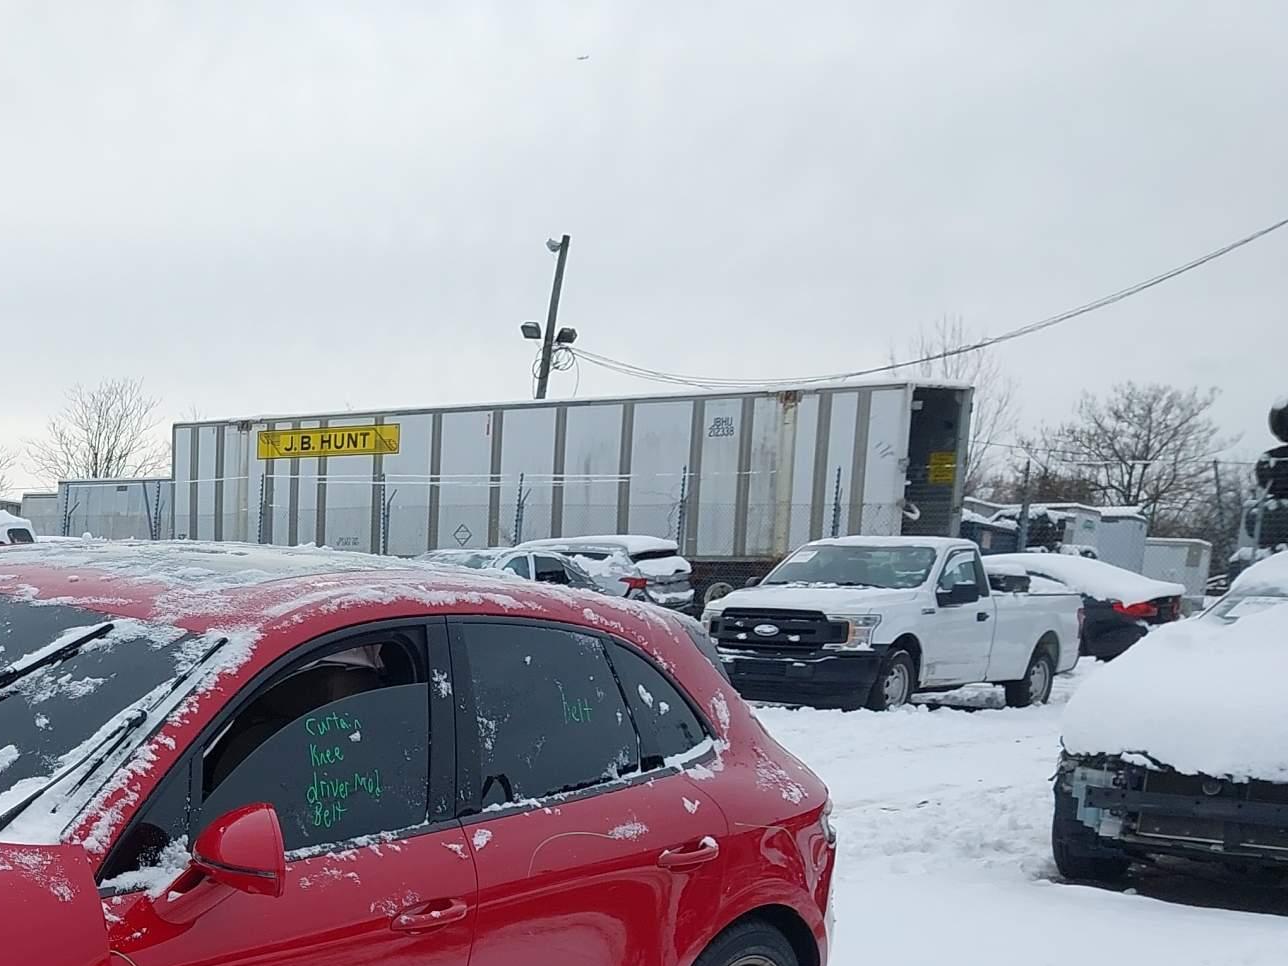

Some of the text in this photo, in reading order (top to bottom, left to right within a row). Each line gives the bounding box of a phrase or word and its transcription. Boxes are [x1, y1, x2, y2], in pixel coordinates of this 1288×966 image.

[284, 431, 370, 452] J.B. HUNT
[310, 744, 344, 766] Knee
[306, 771, 349, 804] driver
[314, 802, 347, 828] Belt
